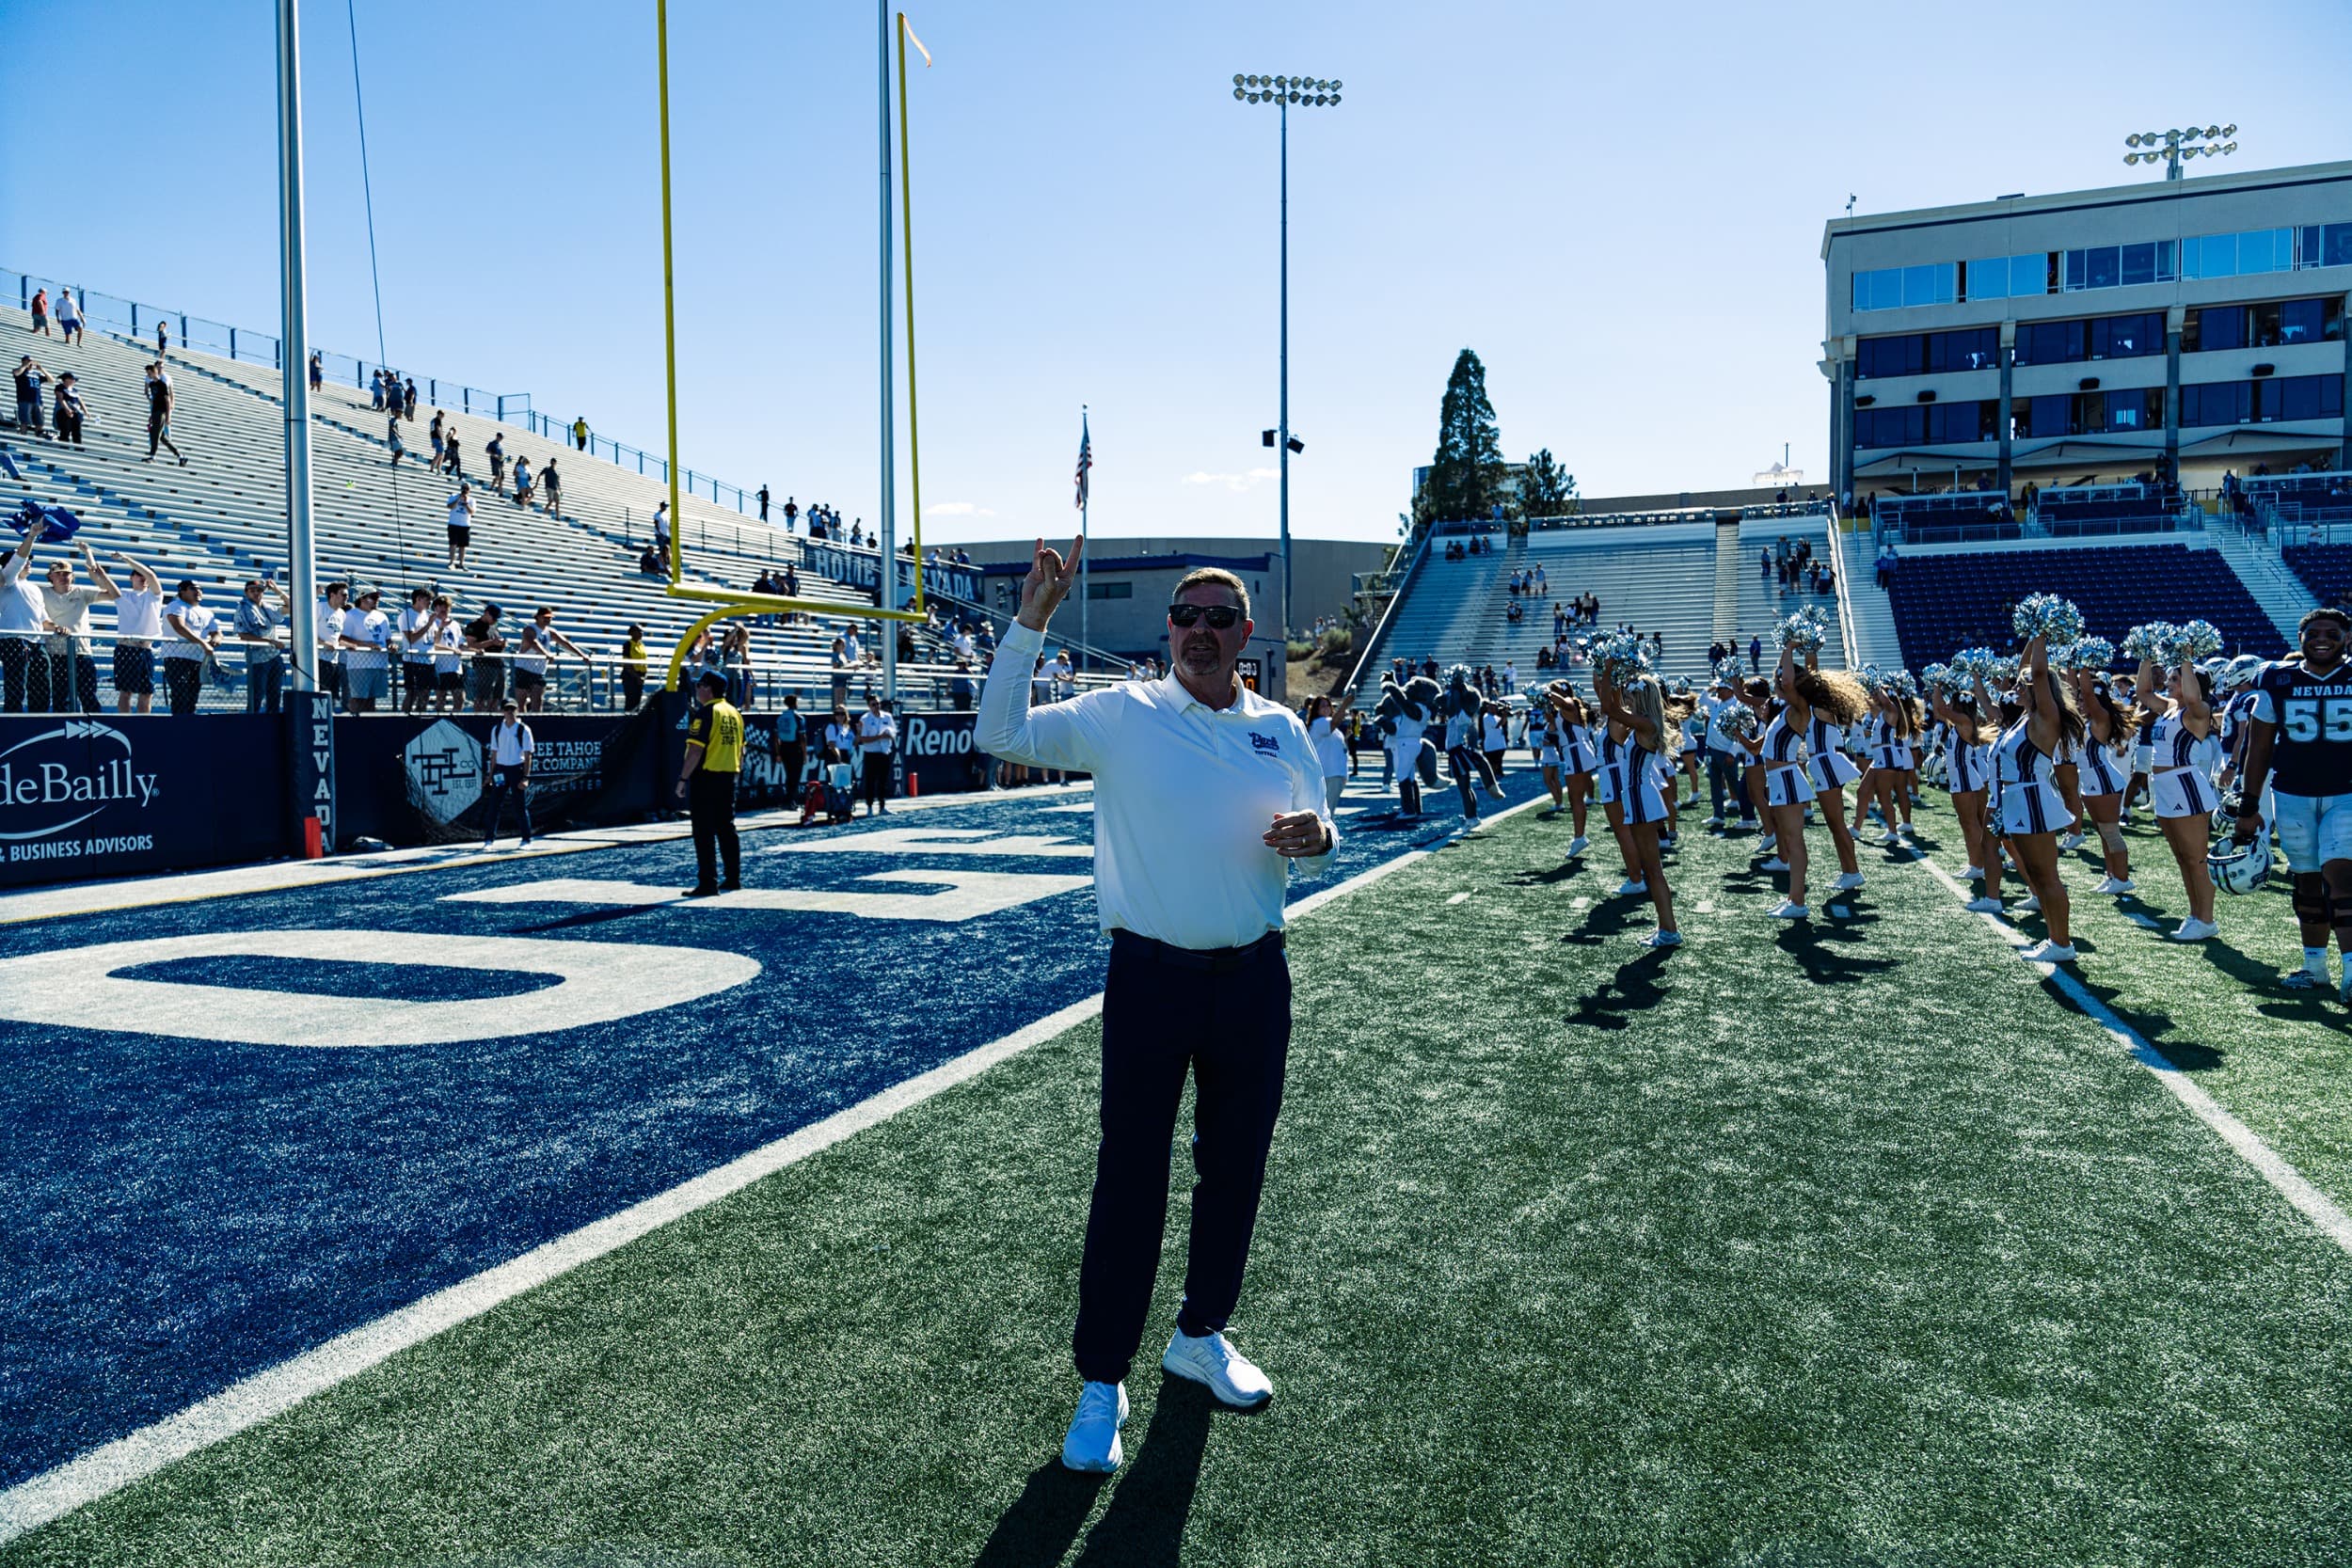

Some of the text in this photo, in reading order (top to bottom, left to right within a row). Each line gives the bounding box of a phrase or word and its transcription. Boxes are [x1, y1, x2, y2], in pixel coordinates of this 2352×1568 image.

[814, 548, 876, 587] HOME
[2293, 685, 2352, 696] NEVADA
[905, 718, 972, 756] Reno
[2284, 699, 2352, 742] 55
[556, 741, 601, 756] TAHOE
[10, 840, 81, 862] BUSINESS
[85, 834, 153, 855] ADVISORS
